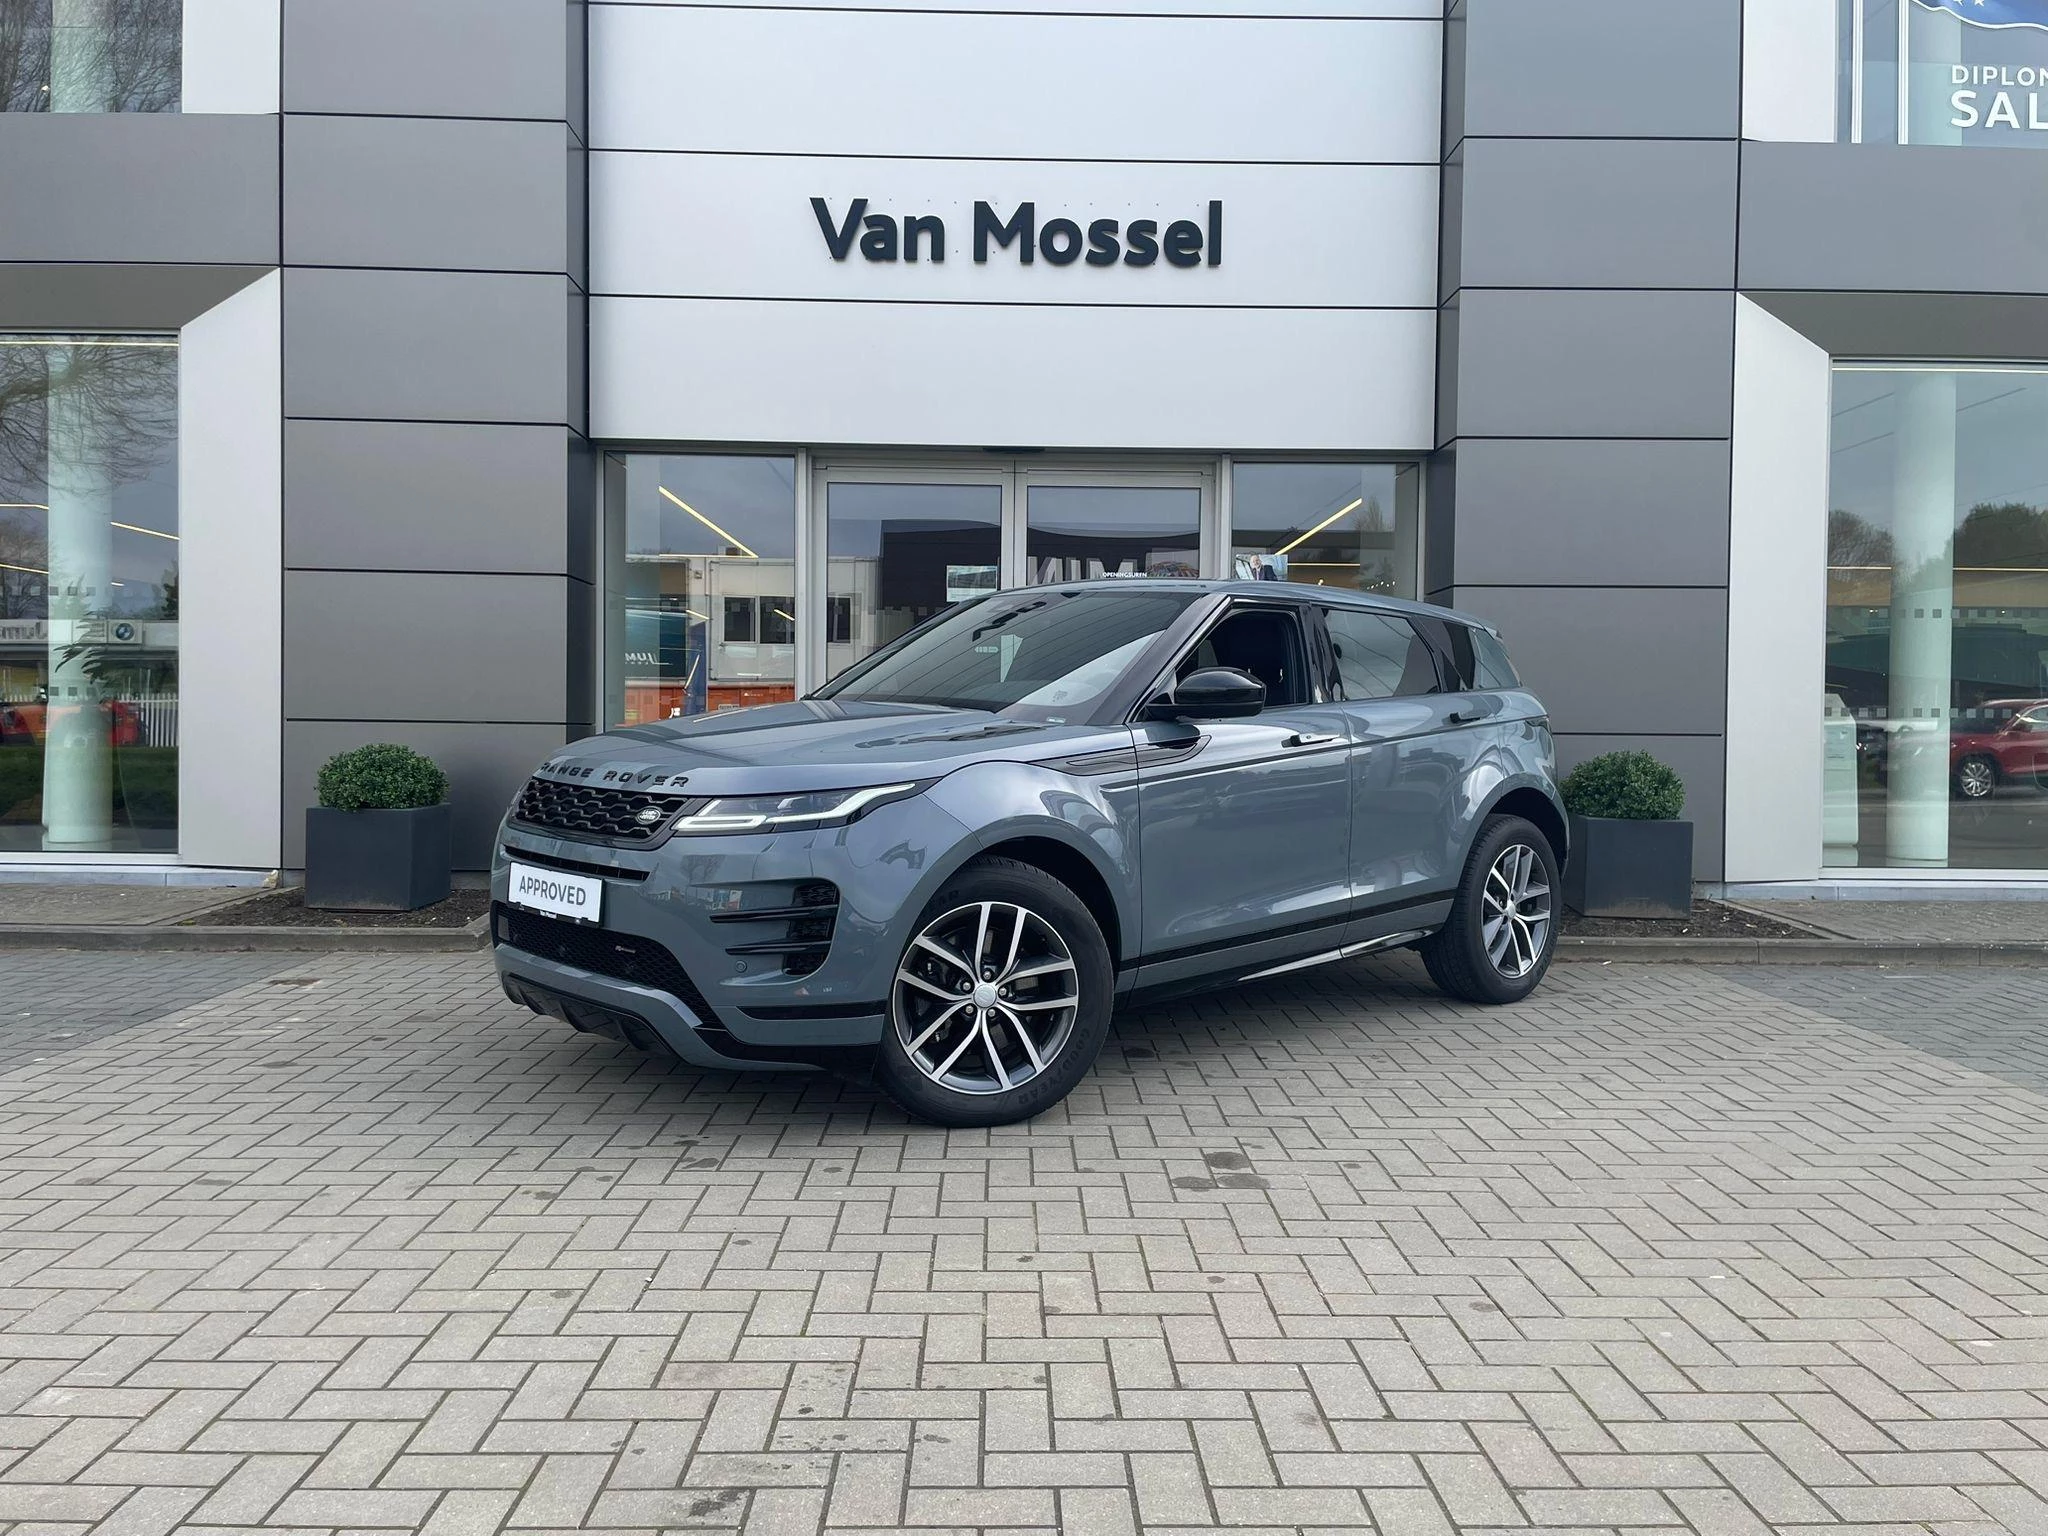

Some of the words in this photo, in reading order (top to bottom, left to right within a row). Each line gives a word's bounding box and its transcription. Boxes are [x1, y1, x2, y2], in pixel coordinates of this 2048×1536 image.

[1951, 89, 2048, 130] SAL
[809, 197, 945, 262] Van
[973, 199, 1223, 266] Mossel
[541, 762, 594, 778] RANGE
[602, 770, 689, 788] ROVER
[519, 875, 587, 906] APPROVED
